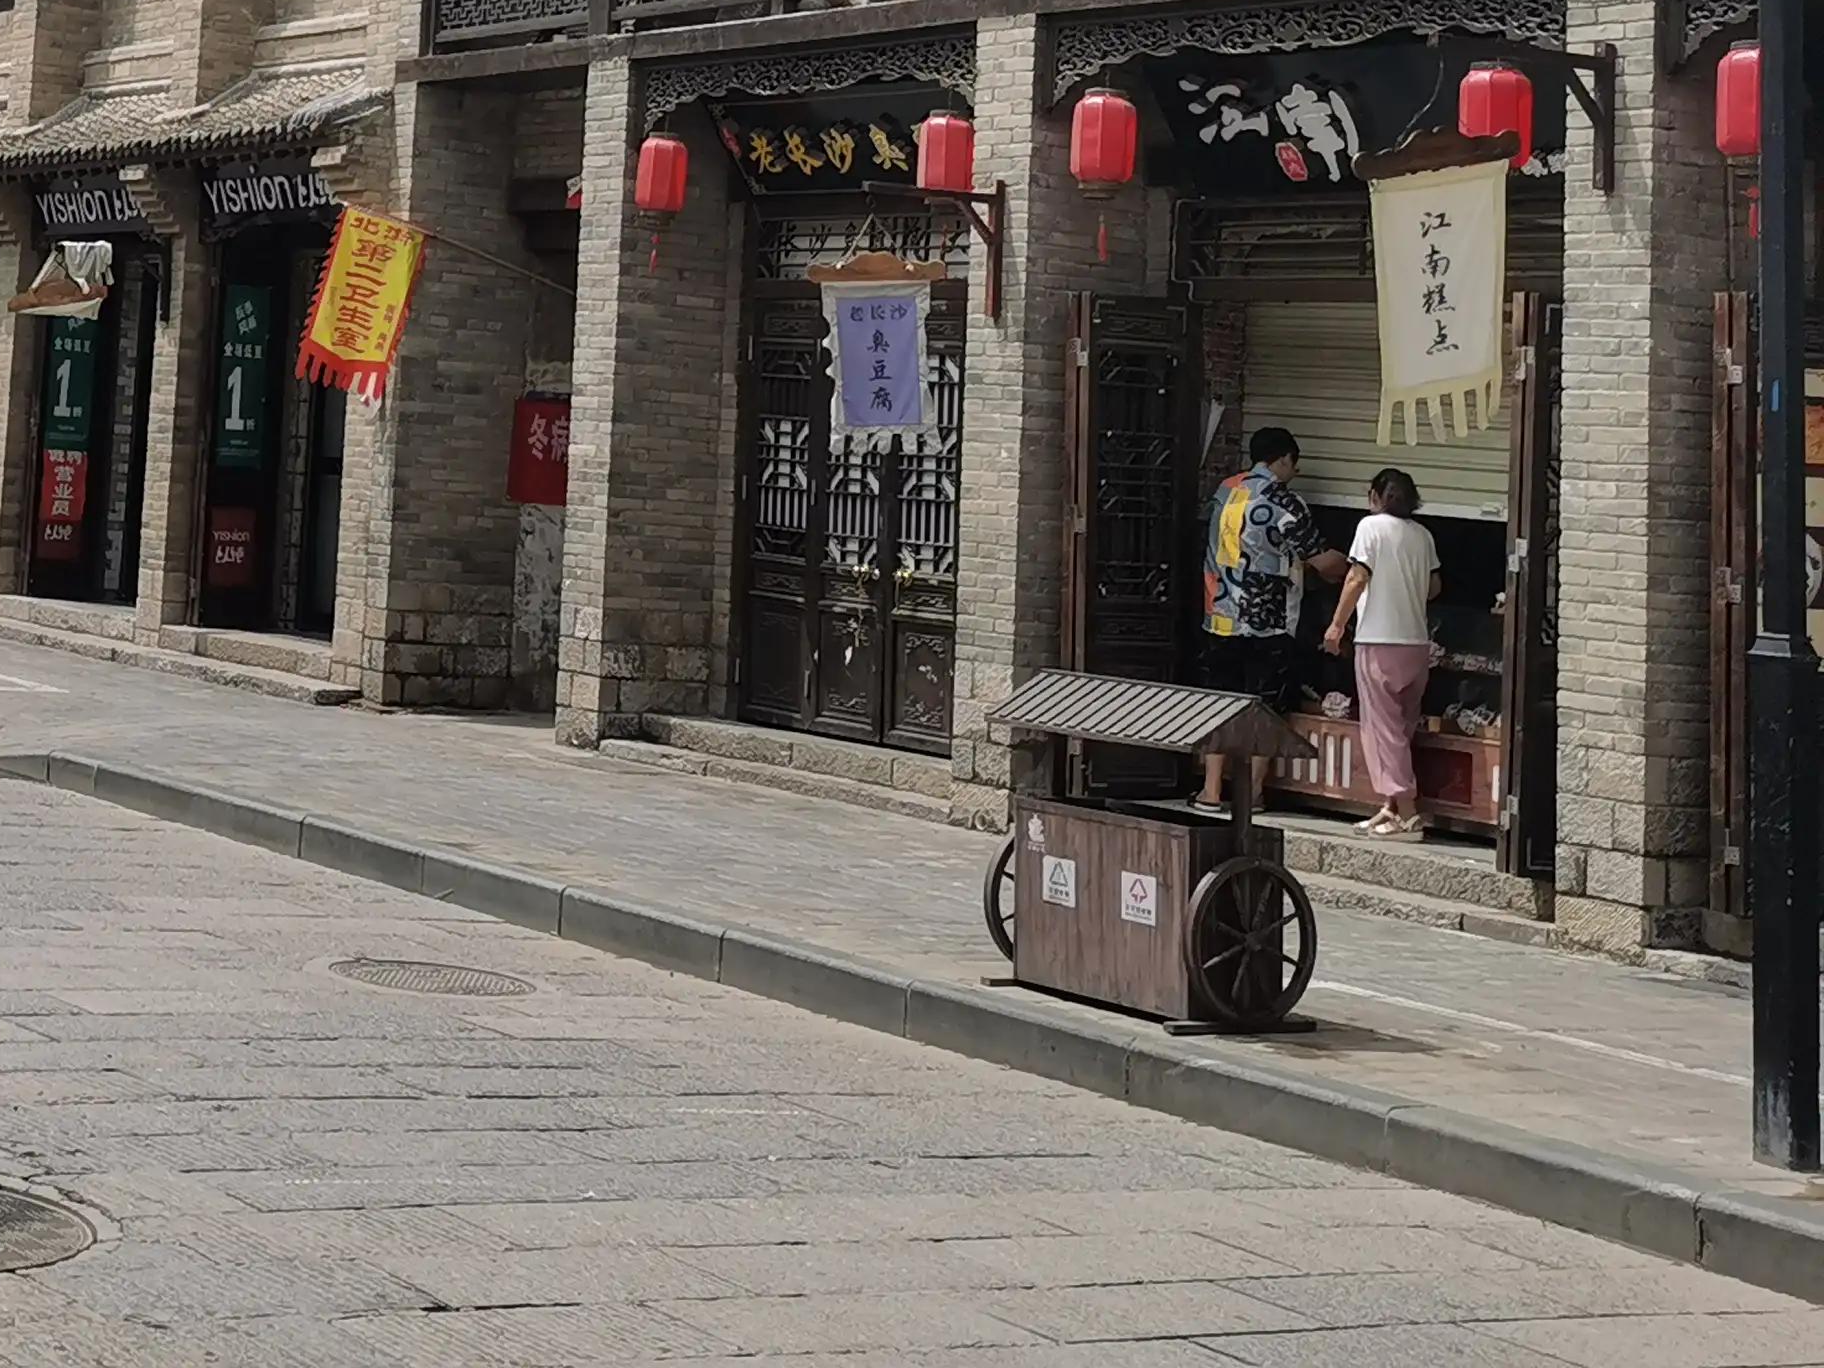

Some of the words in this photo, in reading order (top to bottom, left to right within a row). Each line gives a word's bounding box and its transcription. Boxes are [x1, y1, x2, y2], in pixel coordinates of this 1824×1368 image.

[749, 123, 920, 176] 老长沙臭
[331, 238, 396, 354] 第二卫生室
[1419, 211, 1459, 355] 江南糕点
[866, 329, 893, 412] 臭豆腐
[52, 465, 75, 517] 营业员
